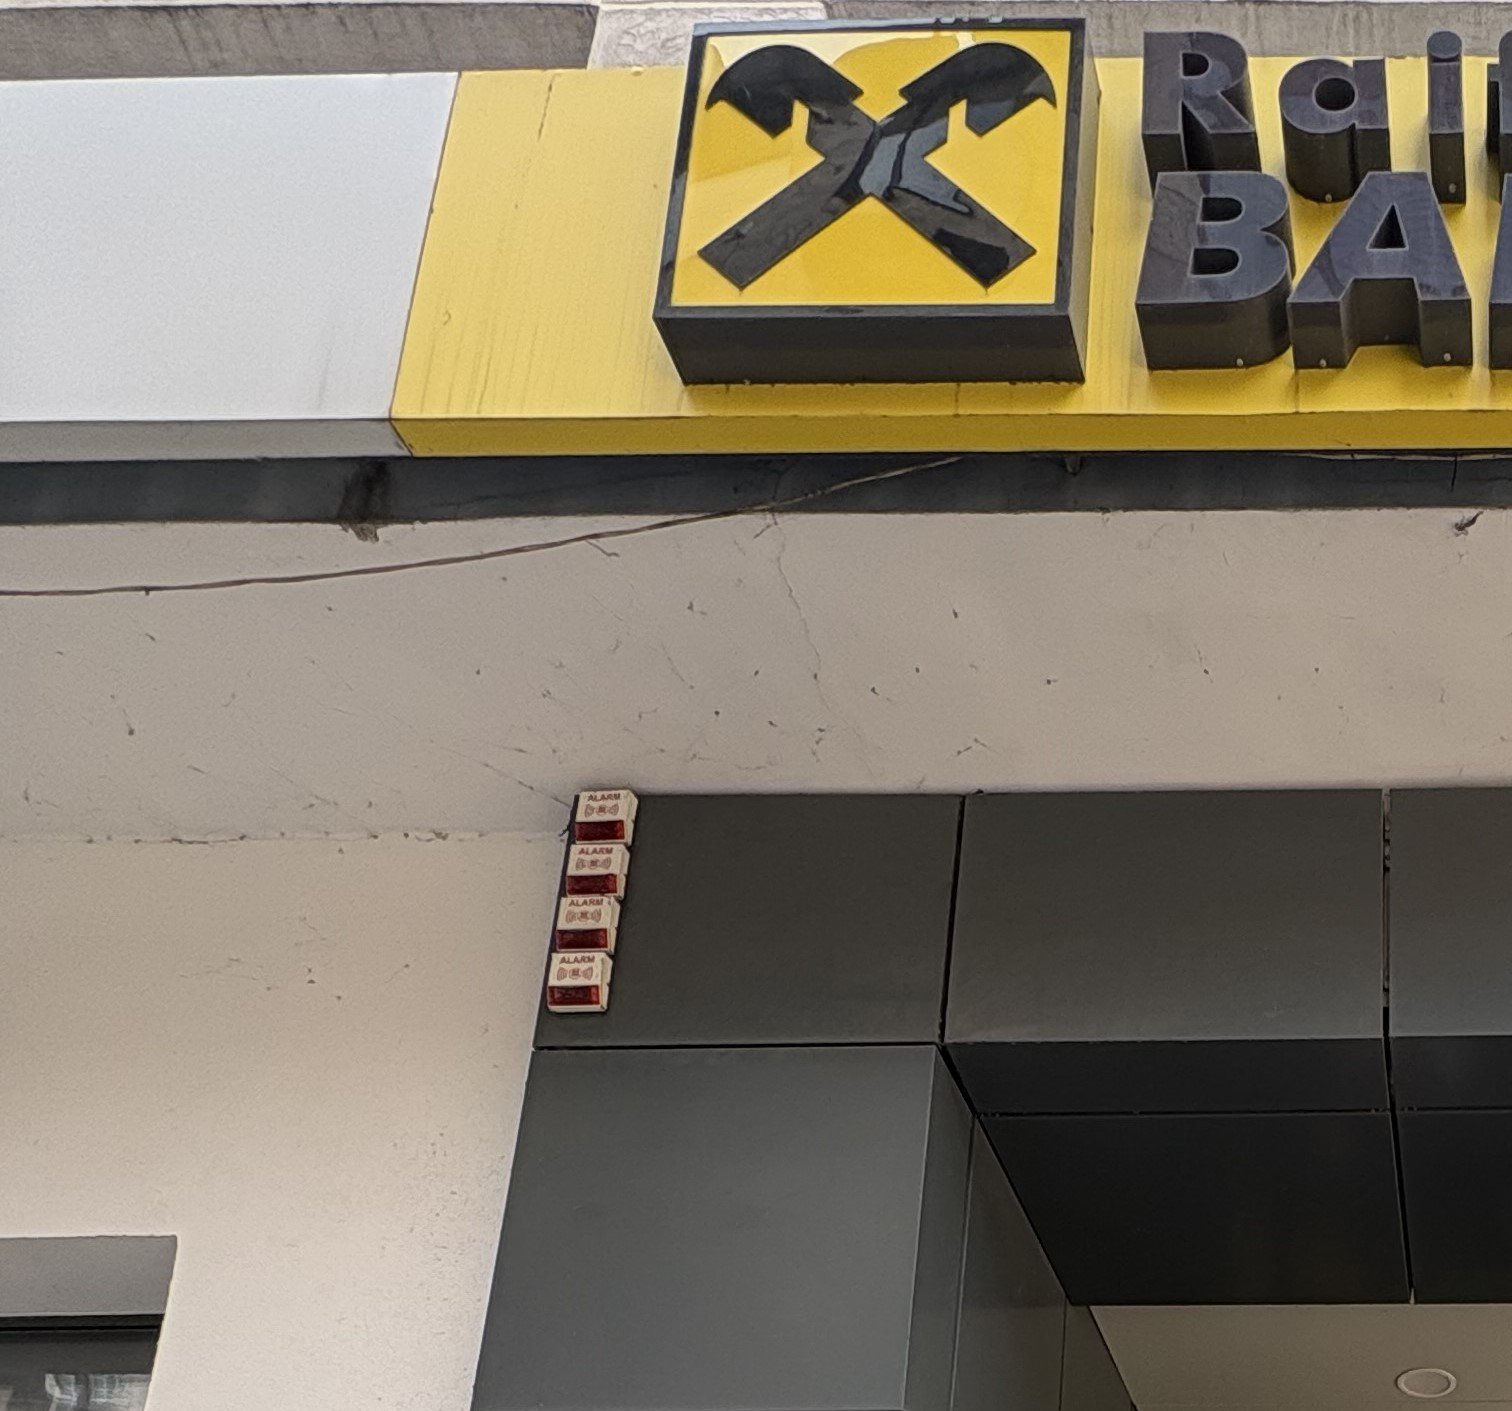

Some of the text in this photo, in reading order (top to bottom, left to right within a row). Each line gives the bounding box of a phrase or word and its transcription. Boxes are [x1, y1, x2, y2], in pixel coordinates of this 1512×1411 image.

[587, 792, 622, 803] ALARM
[578, 846, 614, 856] ALARM
[568, 897, 604, 908] ALARM
[559, 954, 596, 965] ALARM
